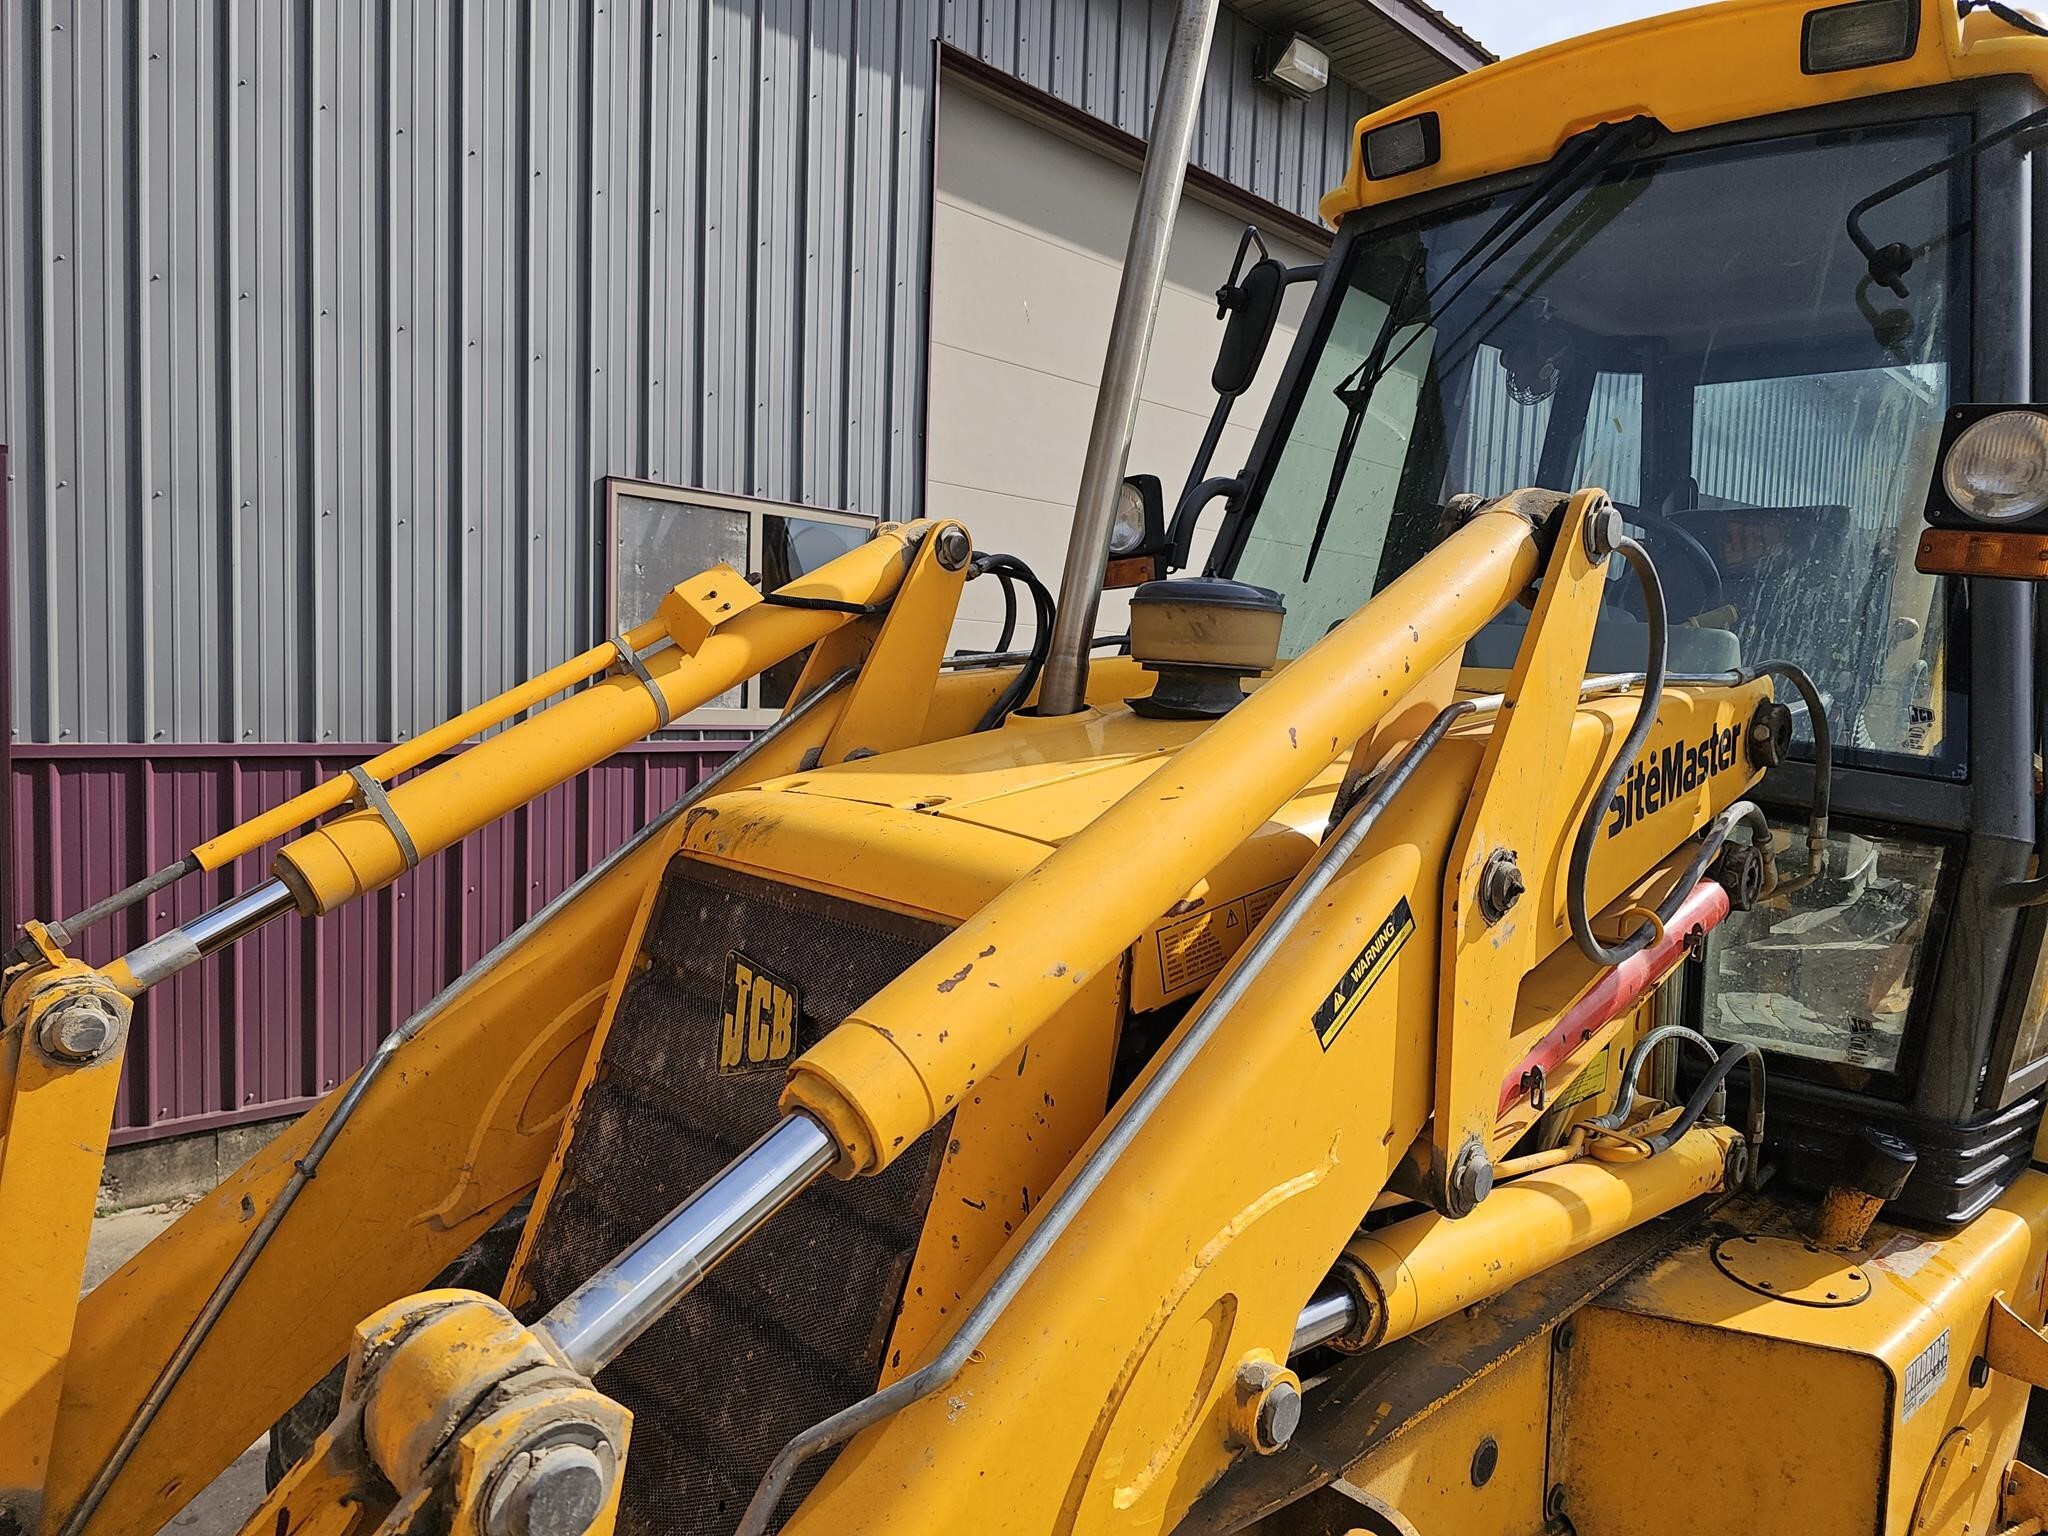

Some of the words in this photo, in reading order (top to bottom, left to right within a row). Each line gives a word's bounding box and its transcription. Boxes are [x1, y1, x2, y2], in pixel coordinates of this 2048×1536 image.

[1608, 722, 1741, 839] SiteMaster
[1351, 922, 1396, 983] WARNING
[721, 963, 793, 1067] JCB
